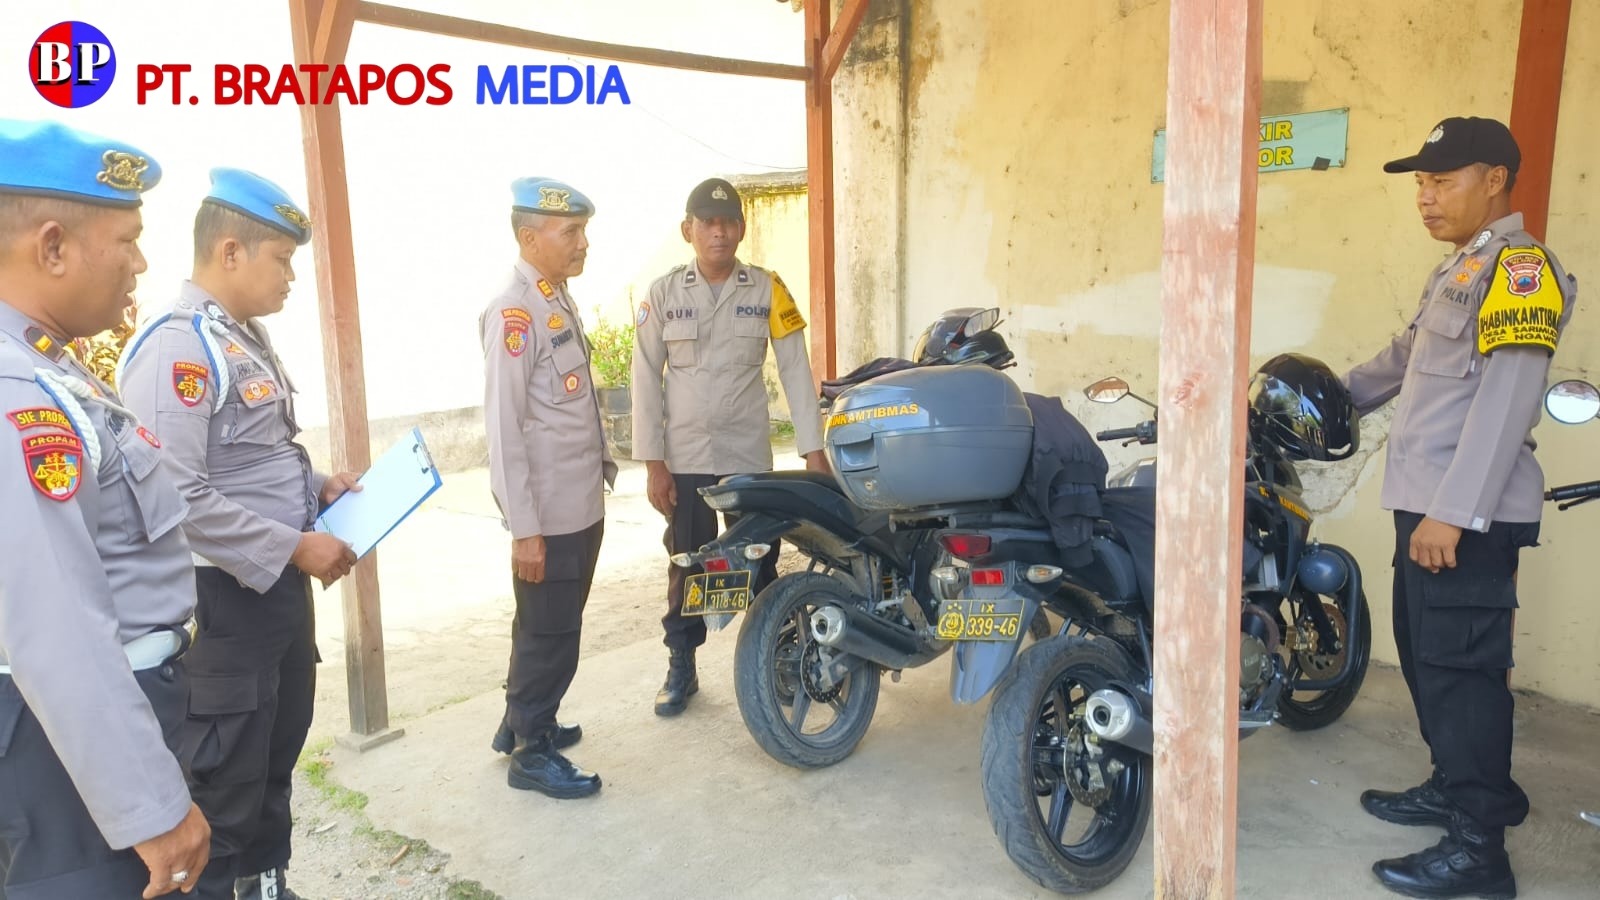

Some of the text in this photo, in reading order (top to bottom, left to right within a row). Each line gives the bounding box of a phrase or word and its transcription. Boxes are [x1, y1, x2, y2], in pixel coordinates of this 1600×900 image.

[1440, 286, 1469, 306] POLRI
[666, 309, 693, 320] GUN
[175, 363, 207, 375] PROPAM
[16, 410, 37, 425] SIE
[29, 436, 77, 447] PROPAM
[967, 617, 1018, 636] 339-46
